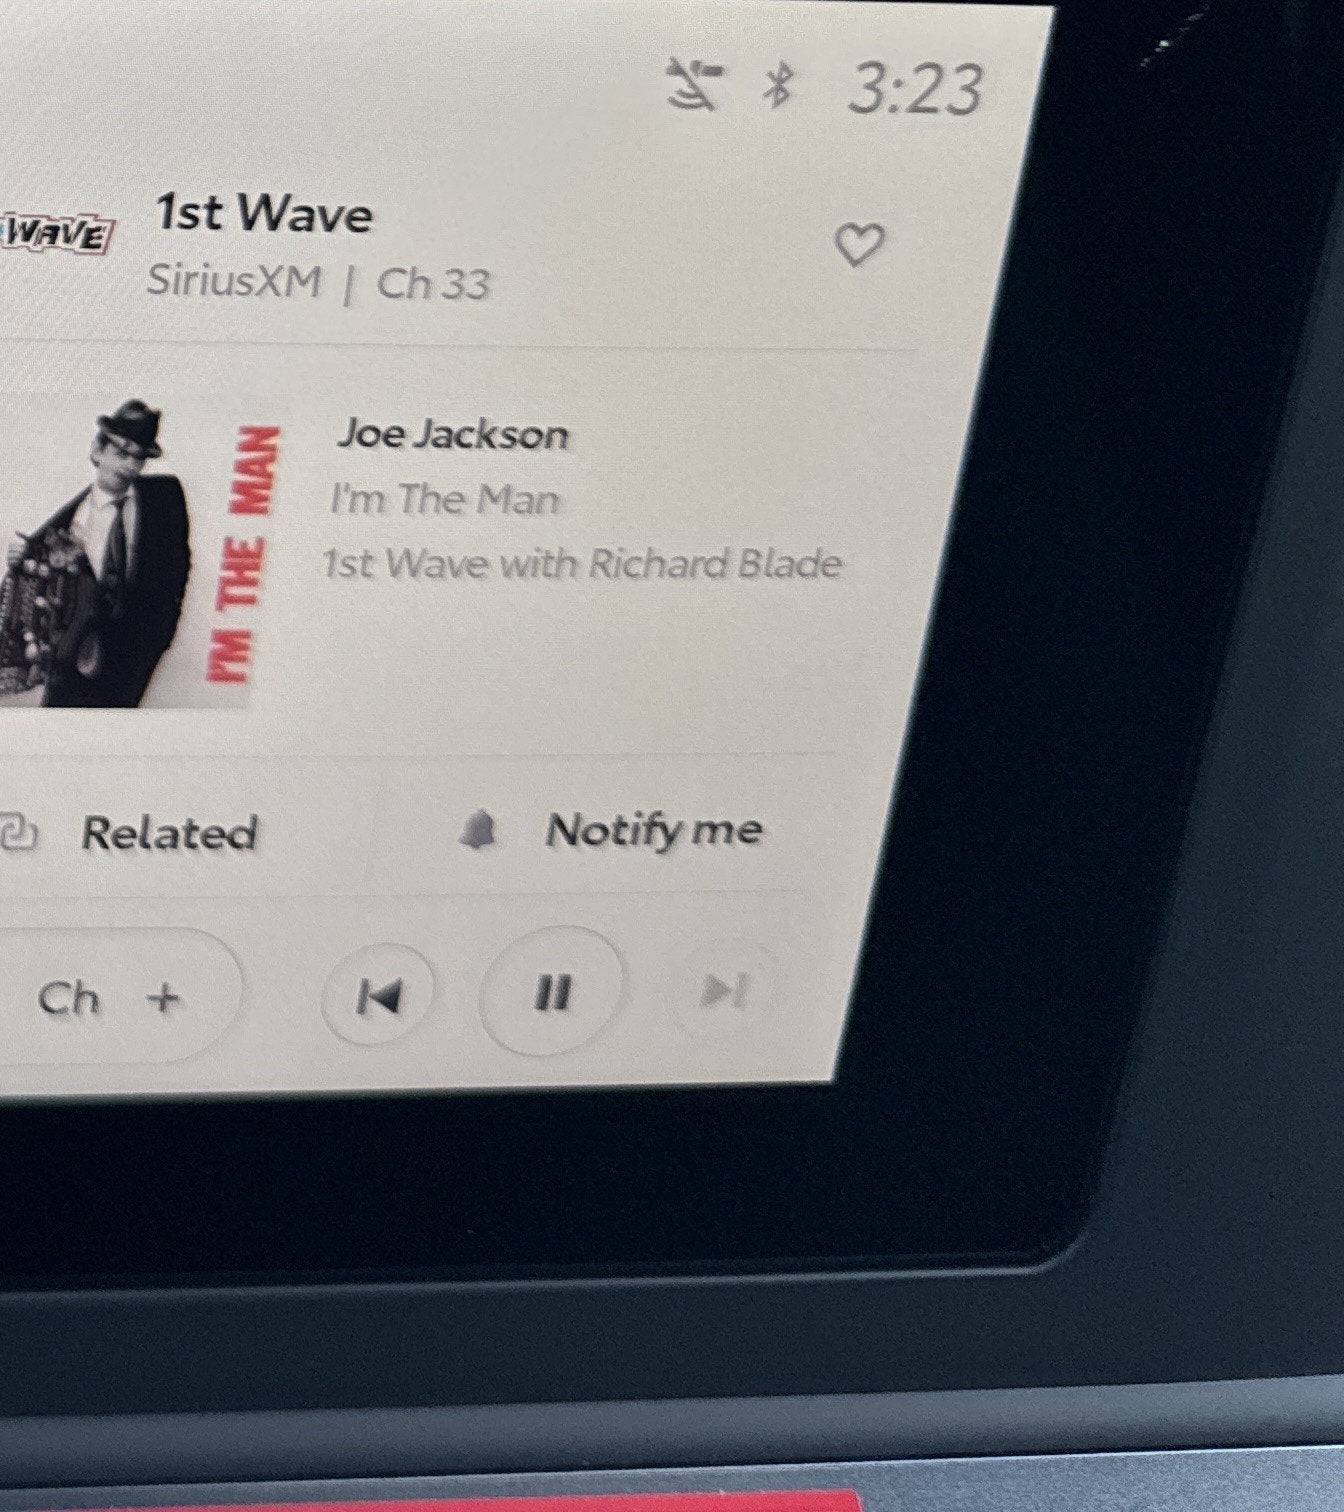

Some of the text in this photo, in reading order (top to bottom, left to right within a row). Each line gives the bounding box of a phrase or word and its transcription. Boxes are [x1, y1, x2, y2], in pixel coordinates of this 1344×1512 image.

[848, 61, 983, 116] 3:23
[158, 192, 372, 233] 1st Wave
[7, 217, 105, 249] WAVE
[147, 262, 321, 297] SiriusXM
[378, 266, 431, 299] Ch
[442, 269, 490, 300] 33
[338, 418, 569, 449] Joe Jackson
[228, 425, 282, 517] MAN
[332, 482, 560, 514] I'm The Man
[215, 536, 266, 613] THE
[324, 547, 843, 579] 1st Wave with Richard Blade
[83, 815, 257, 850] Related
[547, 811, 763, 854] Notify me
[39, 980, 99, 1014] Ch
